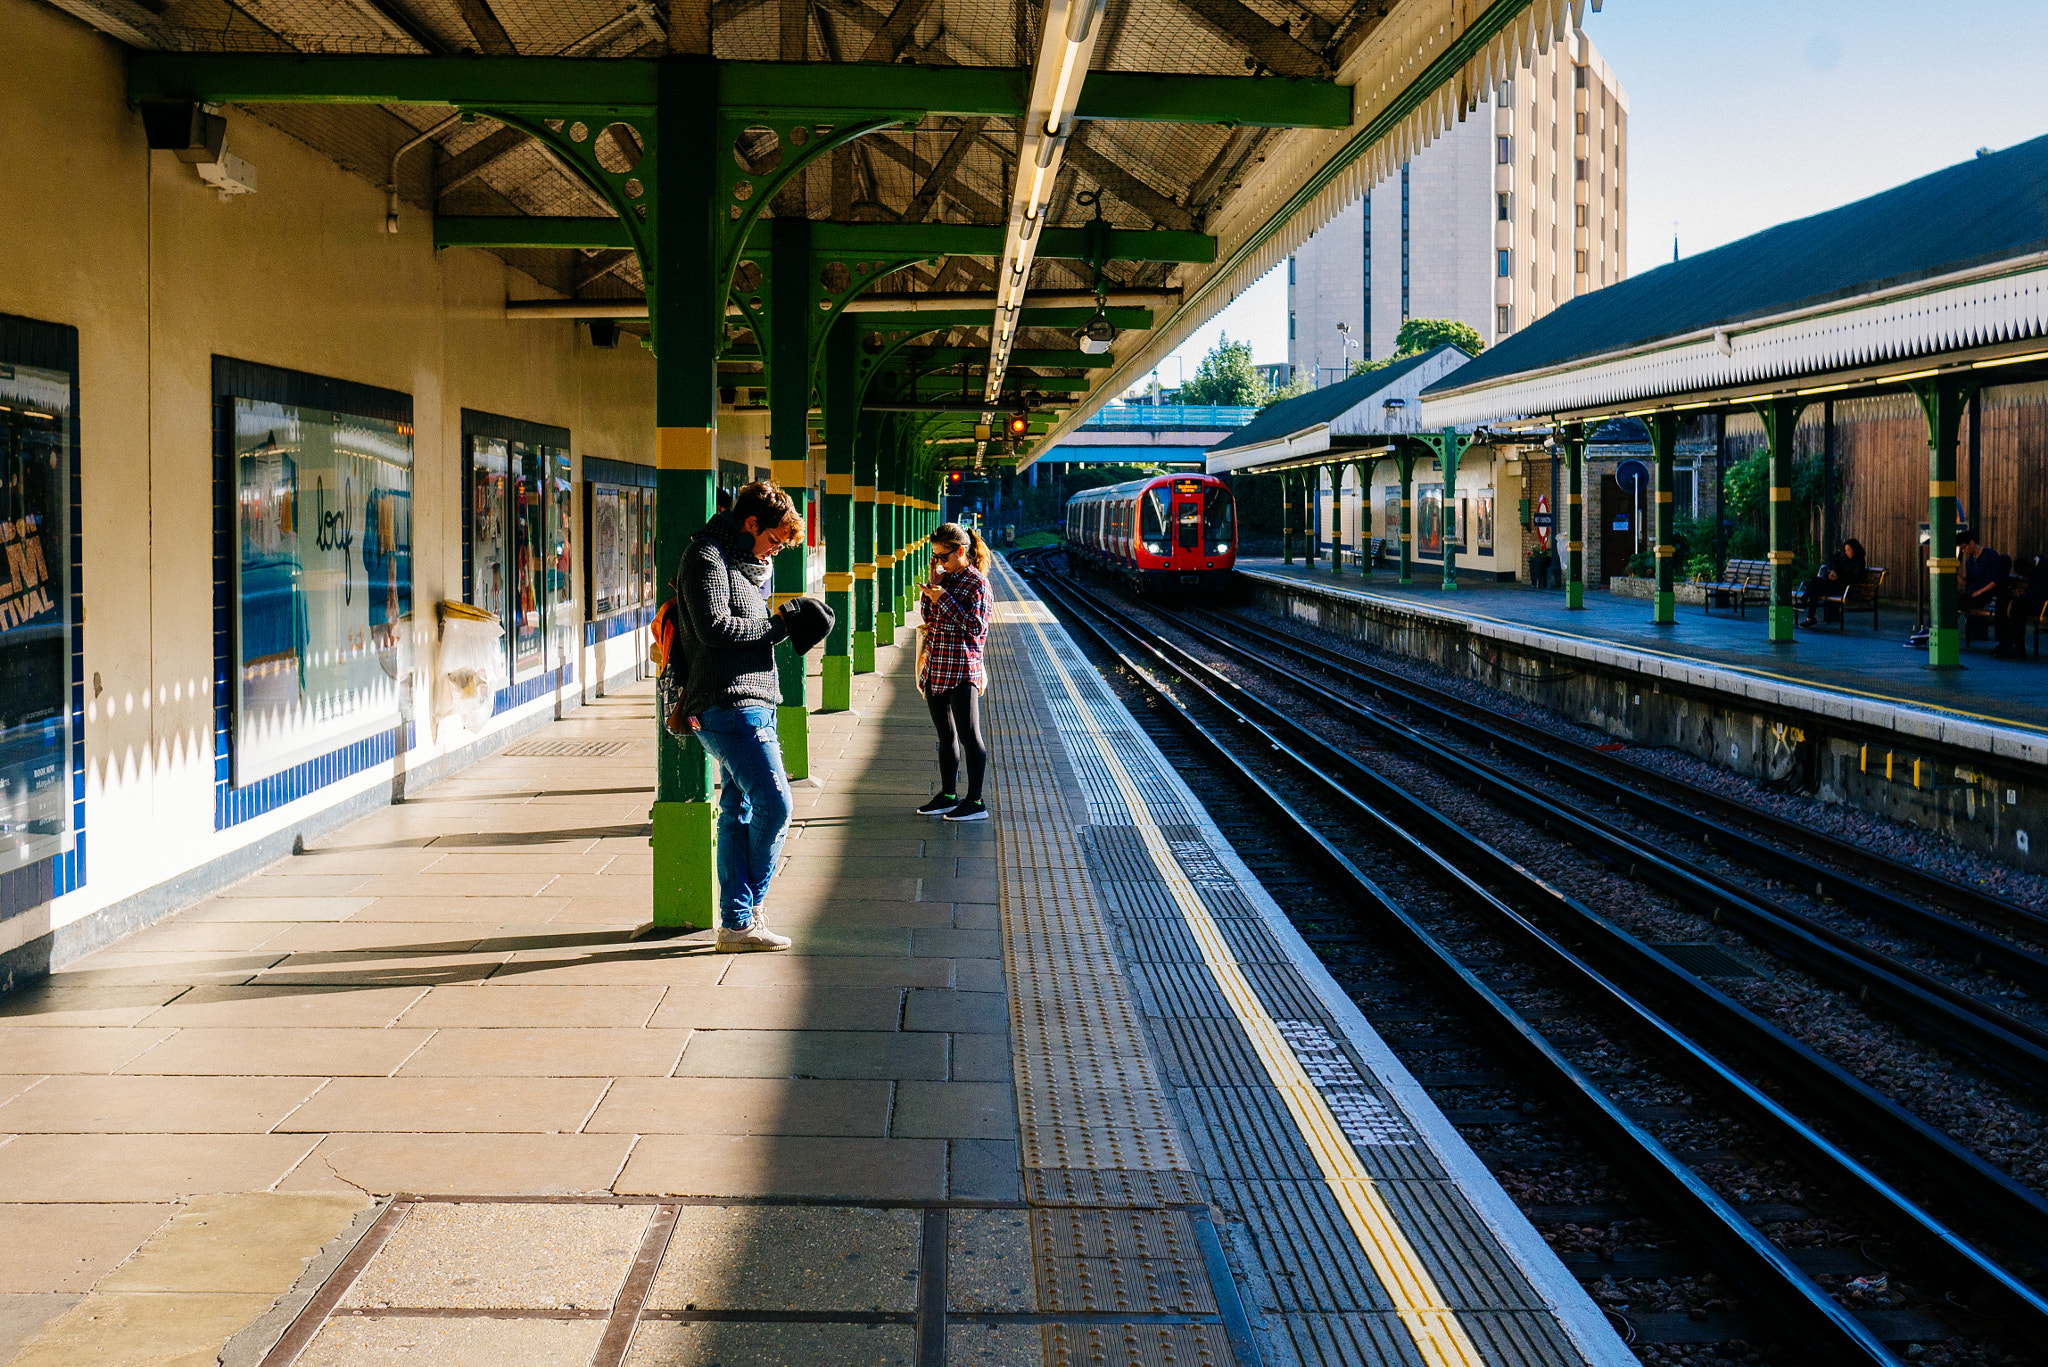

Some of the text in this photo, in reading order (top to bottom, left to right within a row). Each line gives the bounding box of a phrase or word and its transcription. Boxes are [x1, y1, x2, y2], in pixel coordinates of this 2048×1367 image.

[316, 475, 353, 607] loaf
[0, 586, 55, 632] TIVAL
[34, 764, 55, 778] BOOK NOW
[1275, 1020, 1416, 1146] MIND THE GAP
